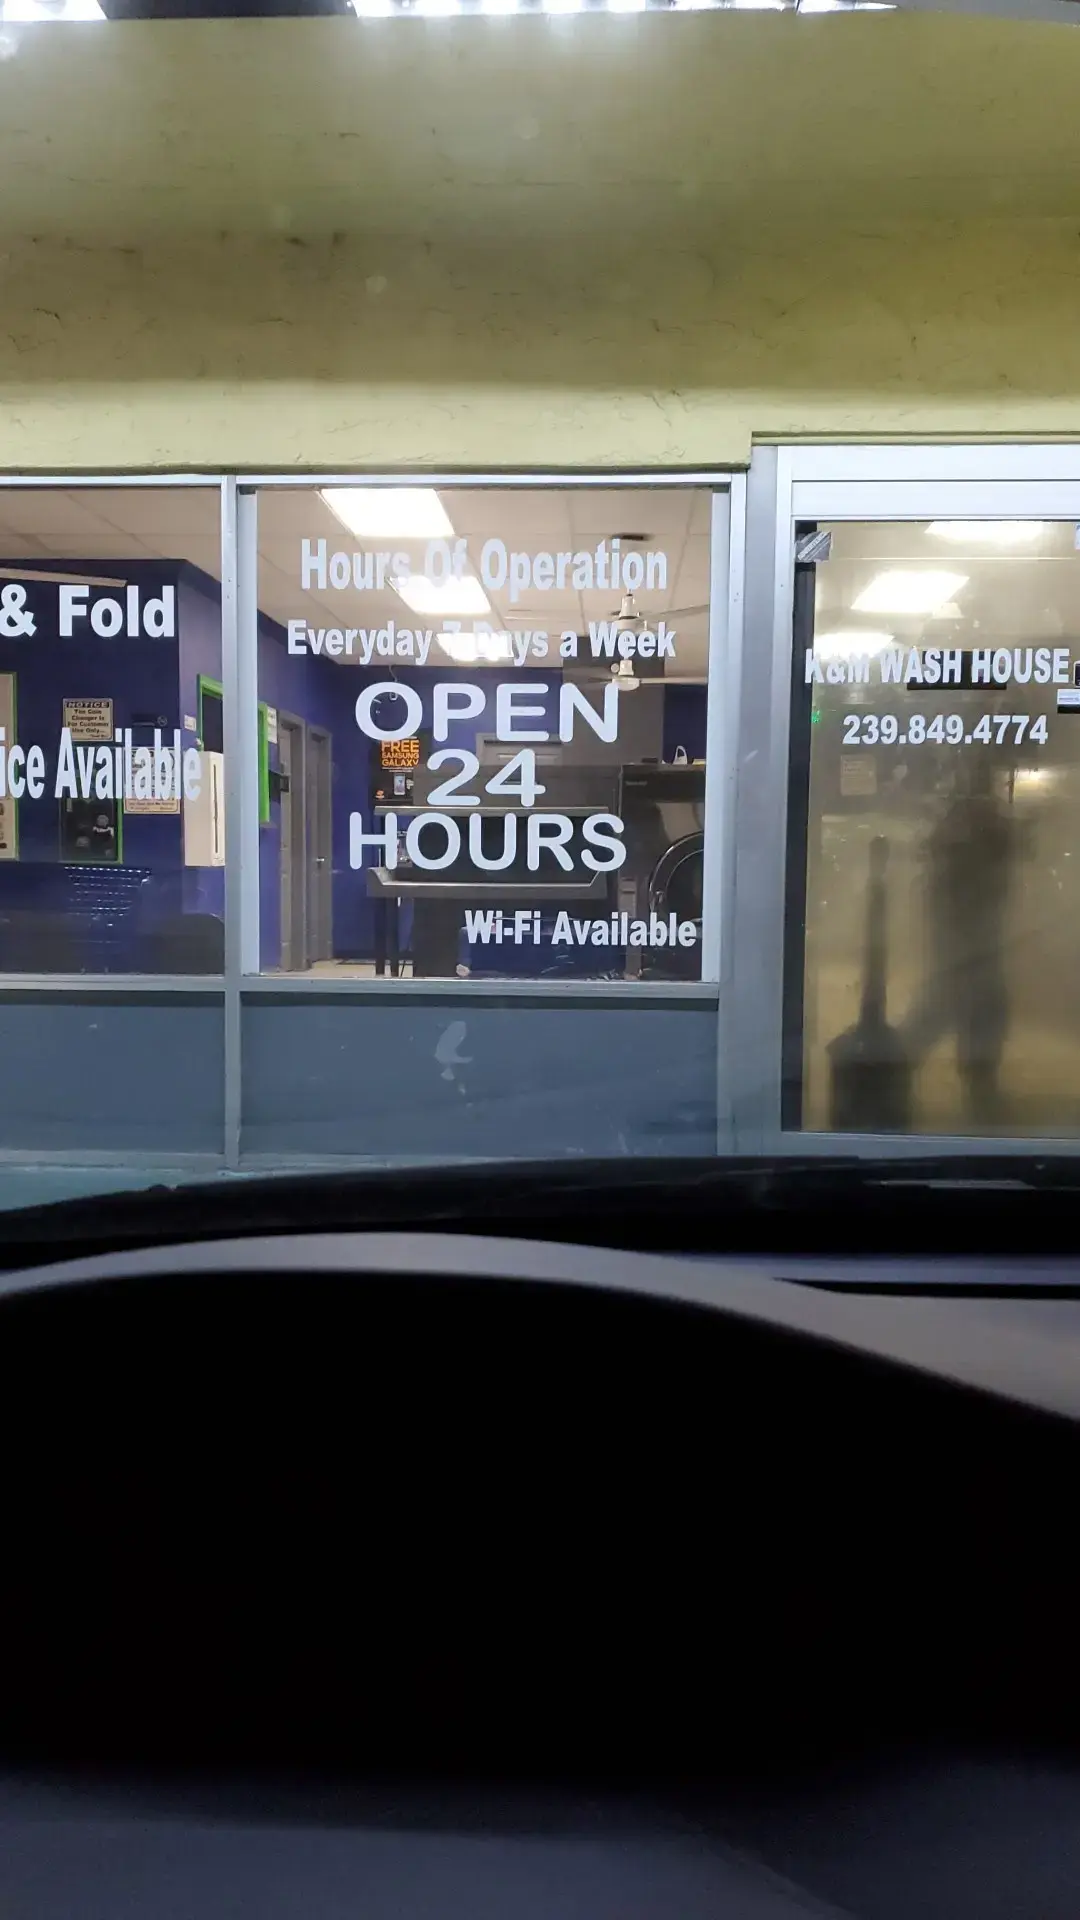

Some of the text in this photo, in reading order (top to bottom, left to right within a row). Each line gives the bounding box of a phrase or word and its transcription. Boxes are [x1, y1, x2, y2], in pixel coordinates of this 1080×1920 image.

[301, 538, 668, 603] Hours Of Operation
[0, 584, 175, 638] & Fold
[287, 619, 432, 665] Everyday
[560, 630, 578, 658] a
[589, 621, 676, 659] Week
[804, 647, 1070, 684] K&M WASH HOUSE
[355, 682, 619, 743] OPEN
[842, 714, 1048, 745] 239.849.4774
[54, 728, 201, 801] Available
[381, 739, 420, 753] FREE
[381, 759, 419, 767] GALAXY
[427, 748, 546, 808] 24
[349, 812, 627, 872] HOURS
[464, 910, 698, 947] Wi-Fi Available
